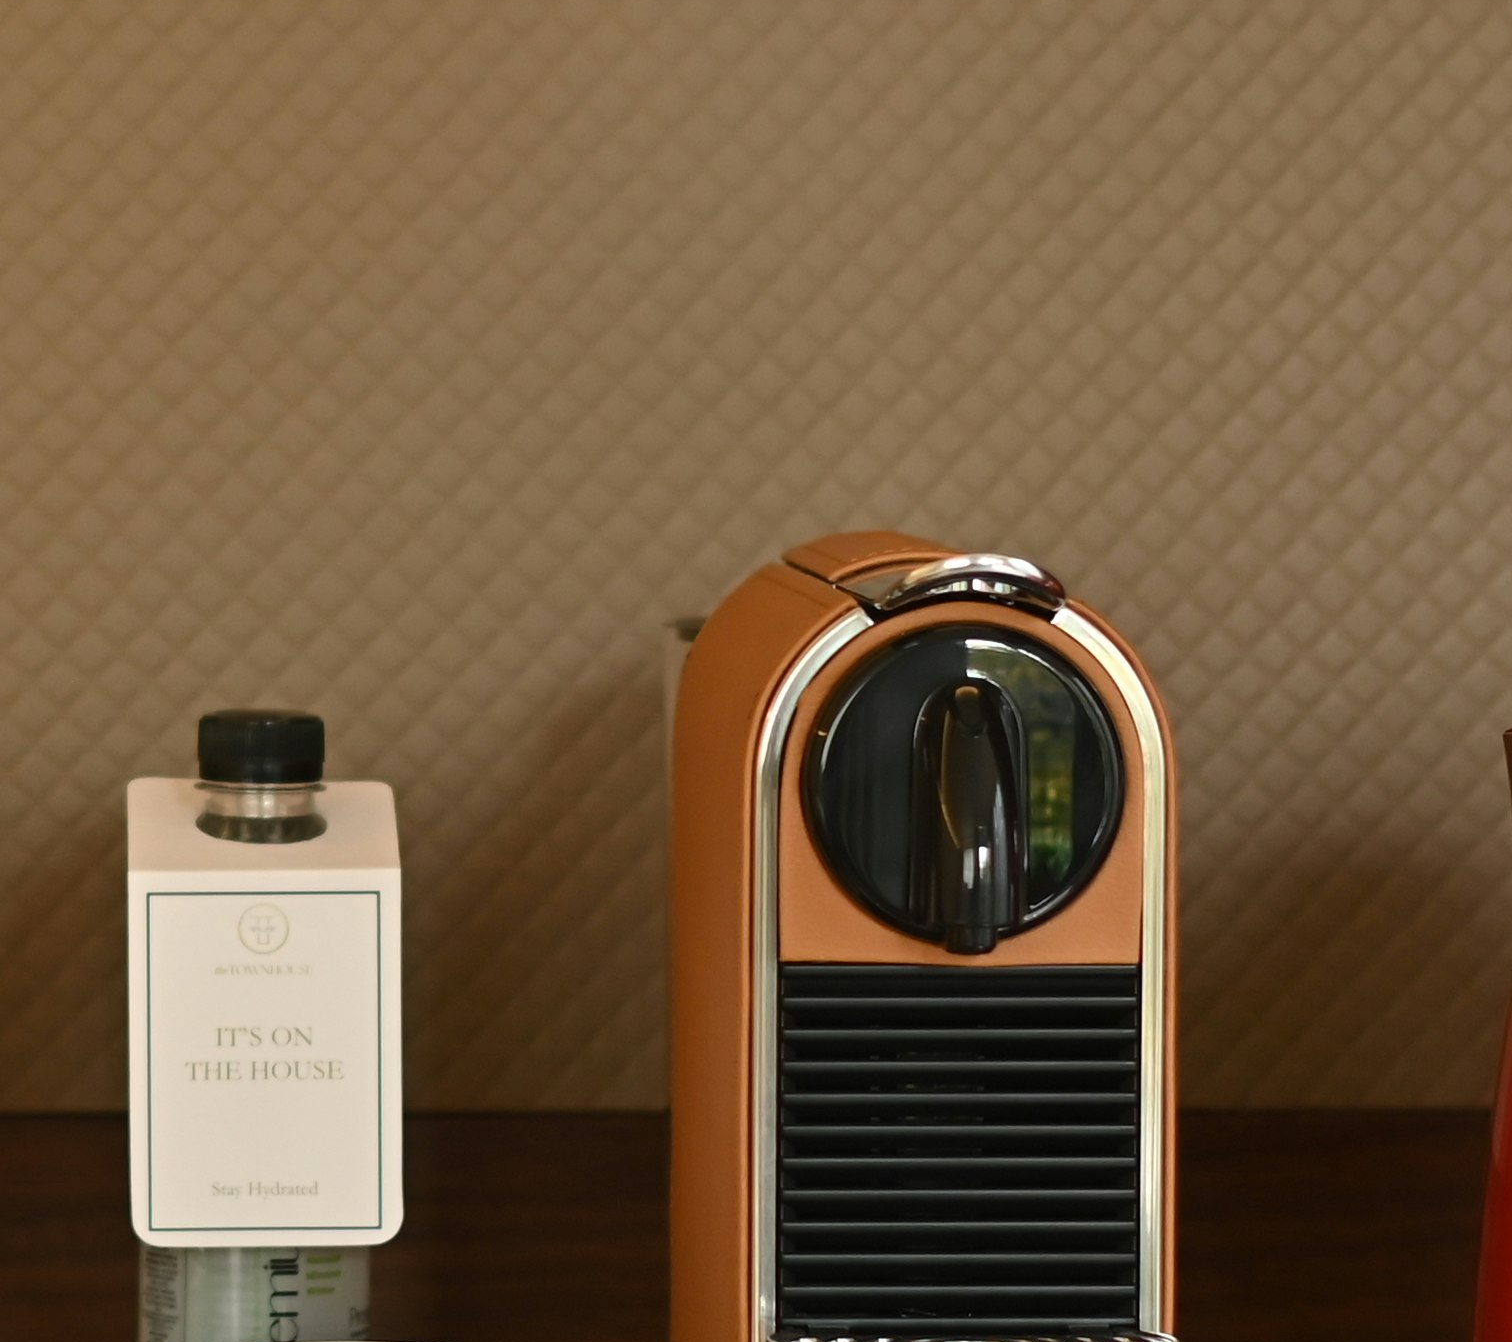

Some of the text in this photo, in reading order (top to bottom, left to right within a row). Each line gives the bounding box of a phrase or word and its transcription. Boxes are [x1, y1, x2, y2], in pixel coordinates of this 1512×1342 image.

[271, 1026, 312, 1047] ON
[184, 1061, 344, 1081] THE HOUSE
[211, 1181, 318, 1200] Stay Hydrated
